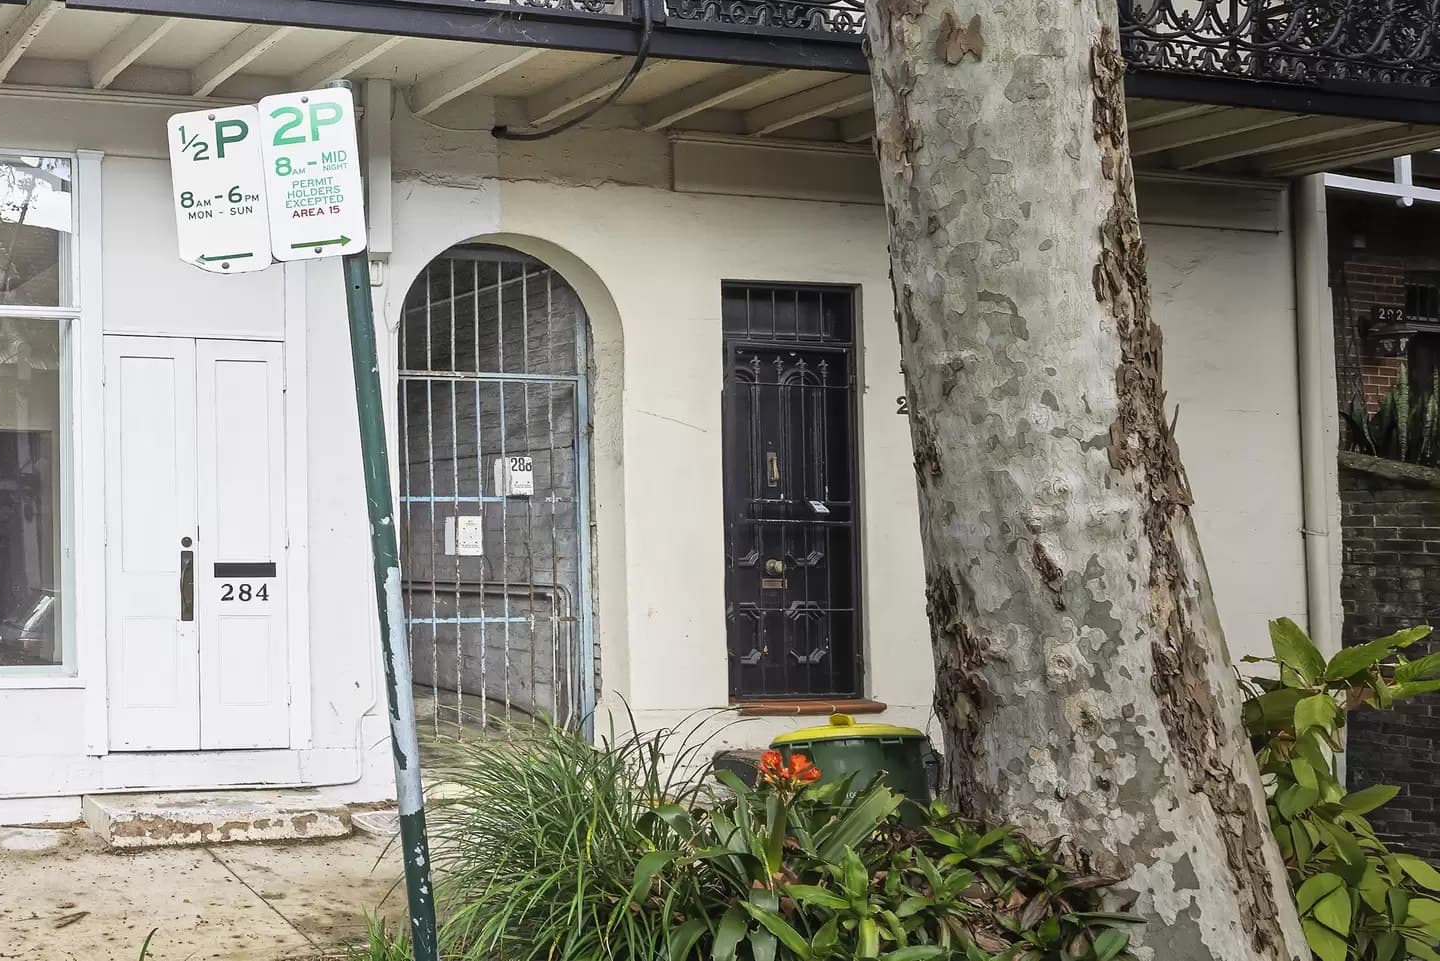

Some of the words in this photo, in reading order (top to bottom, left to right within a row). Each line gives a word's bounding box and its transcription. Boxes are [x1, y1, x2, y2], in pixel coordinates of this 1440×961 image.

[269, 102, 343, 146] 2P
[321, 150, 347, 164] MID
[322, 163, 349, 172] NIGHT
[292, 177, 334, 189] PERMIT
[287, 185, 341, 199] HOLDERS
[285, 195, 344, 208] EXCEPTED
[188, 210, 213, 220] MON
[230, 206, 253, 216] SUN
[292, 207, 325, 218] AREA
[329, 205, 340, 214] 15
[220, 583, 270, 602] 284
